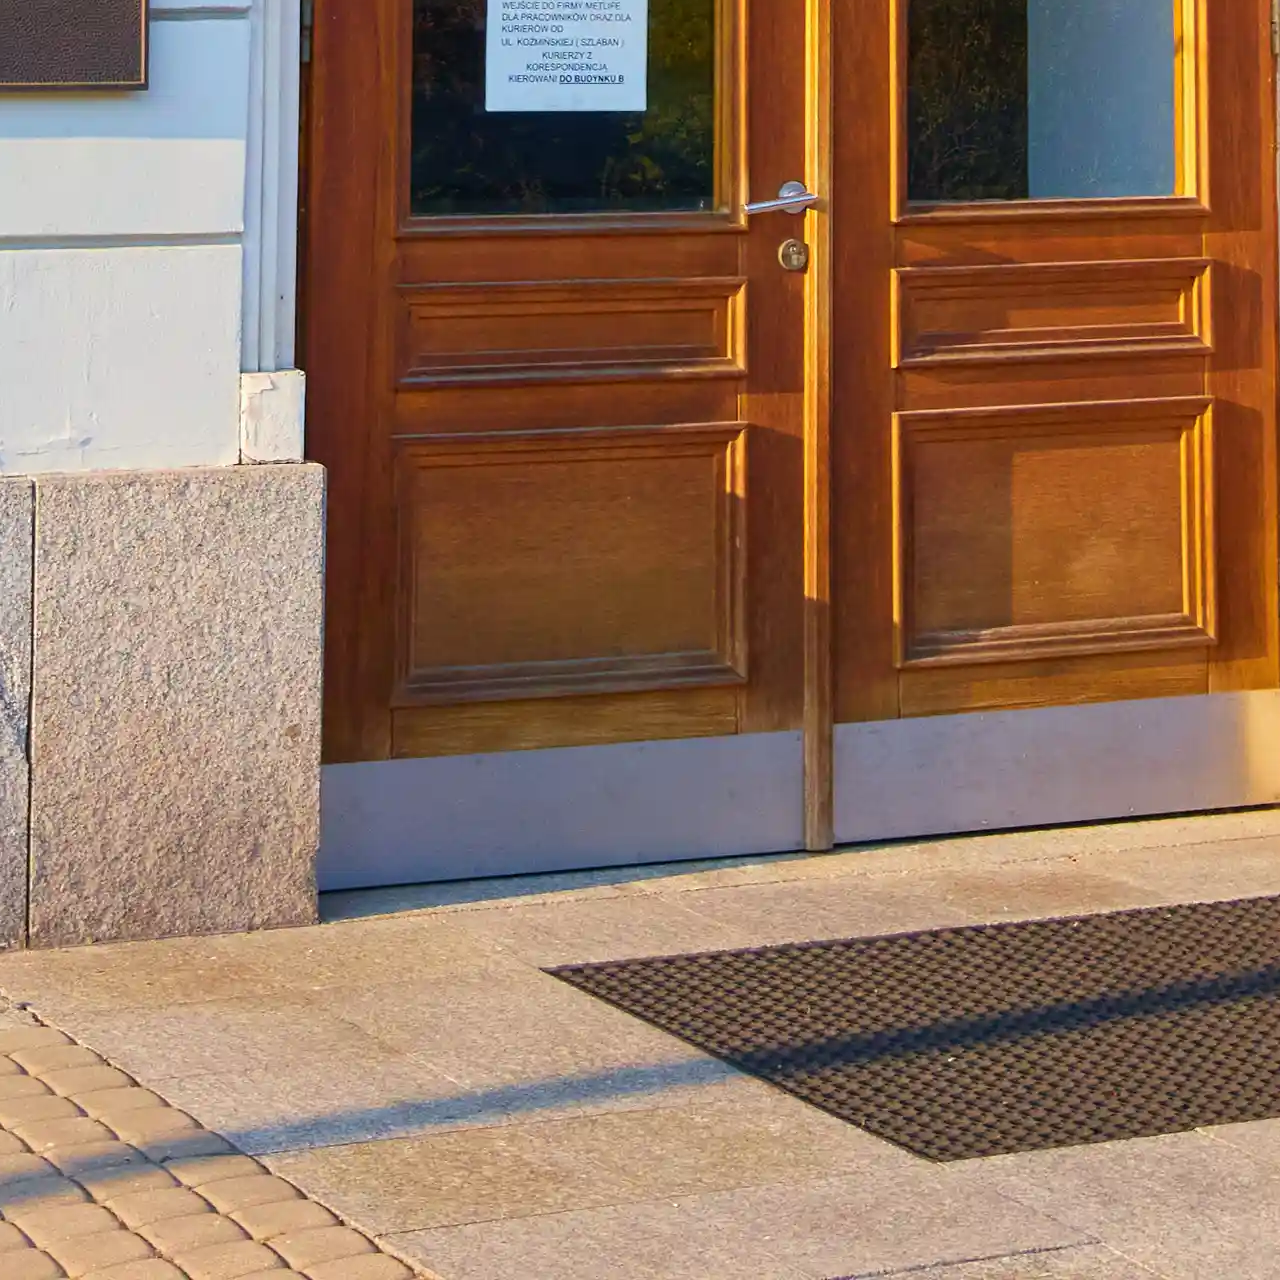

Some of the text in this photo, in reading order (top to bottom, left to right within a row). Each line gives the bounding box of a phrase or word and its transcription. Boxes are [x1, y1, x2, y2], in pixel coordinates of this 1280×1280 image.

[501, 0, 621, 11] WEJŚCIE DO FIRMY METLIFE
[501, 12, 632, 22] DLA PRACOWNIKÓW ORAZ DLA
[550, 24, 564, 33] OD
[542, 51, 585, 60] KURIERZY
[508, 74, 557, 83] KIEROWANI
[559, 74, 572, 83] DO
[574, 74, 617, 83] BUDYNKU
